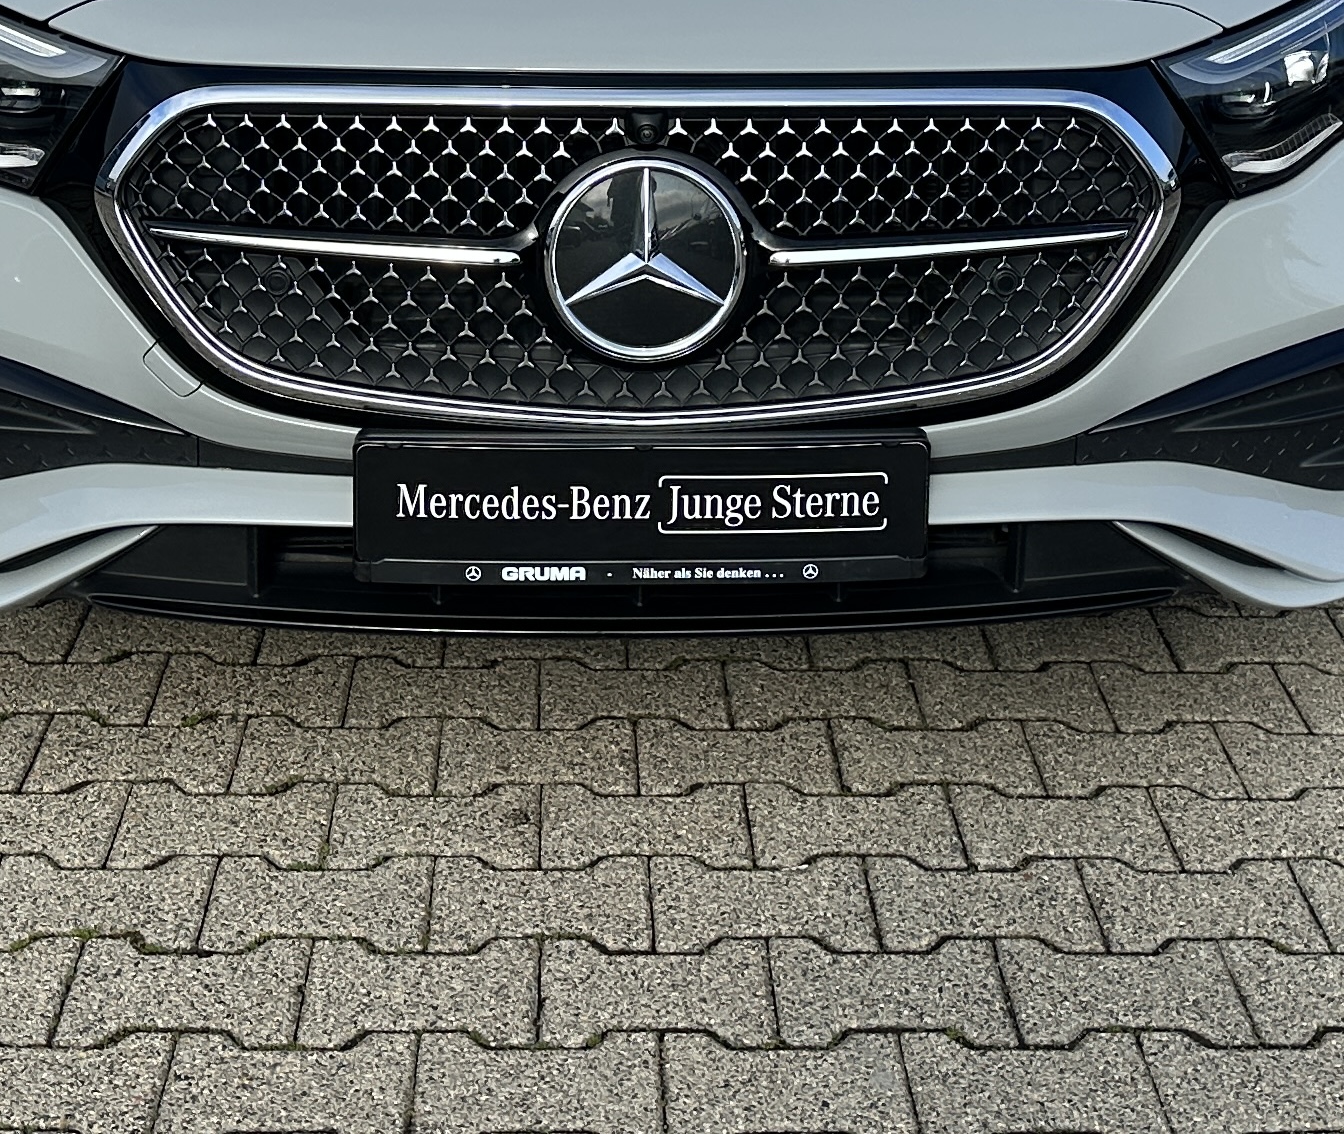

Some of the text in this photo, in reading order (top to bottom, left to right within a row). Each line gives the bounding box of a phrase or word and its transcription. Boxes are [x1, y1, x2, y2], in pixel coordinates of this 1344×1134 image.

[395, 482, 881, 528] Mercedes-Benz Junge Sterne
[501, 566, 586, 582] GRUMA
[632, 567, 671, 580] Näher
[674, 567, 692, 579] als
[694, 567, 714, 579] Sie
[716, 567, 762, 579] denken
